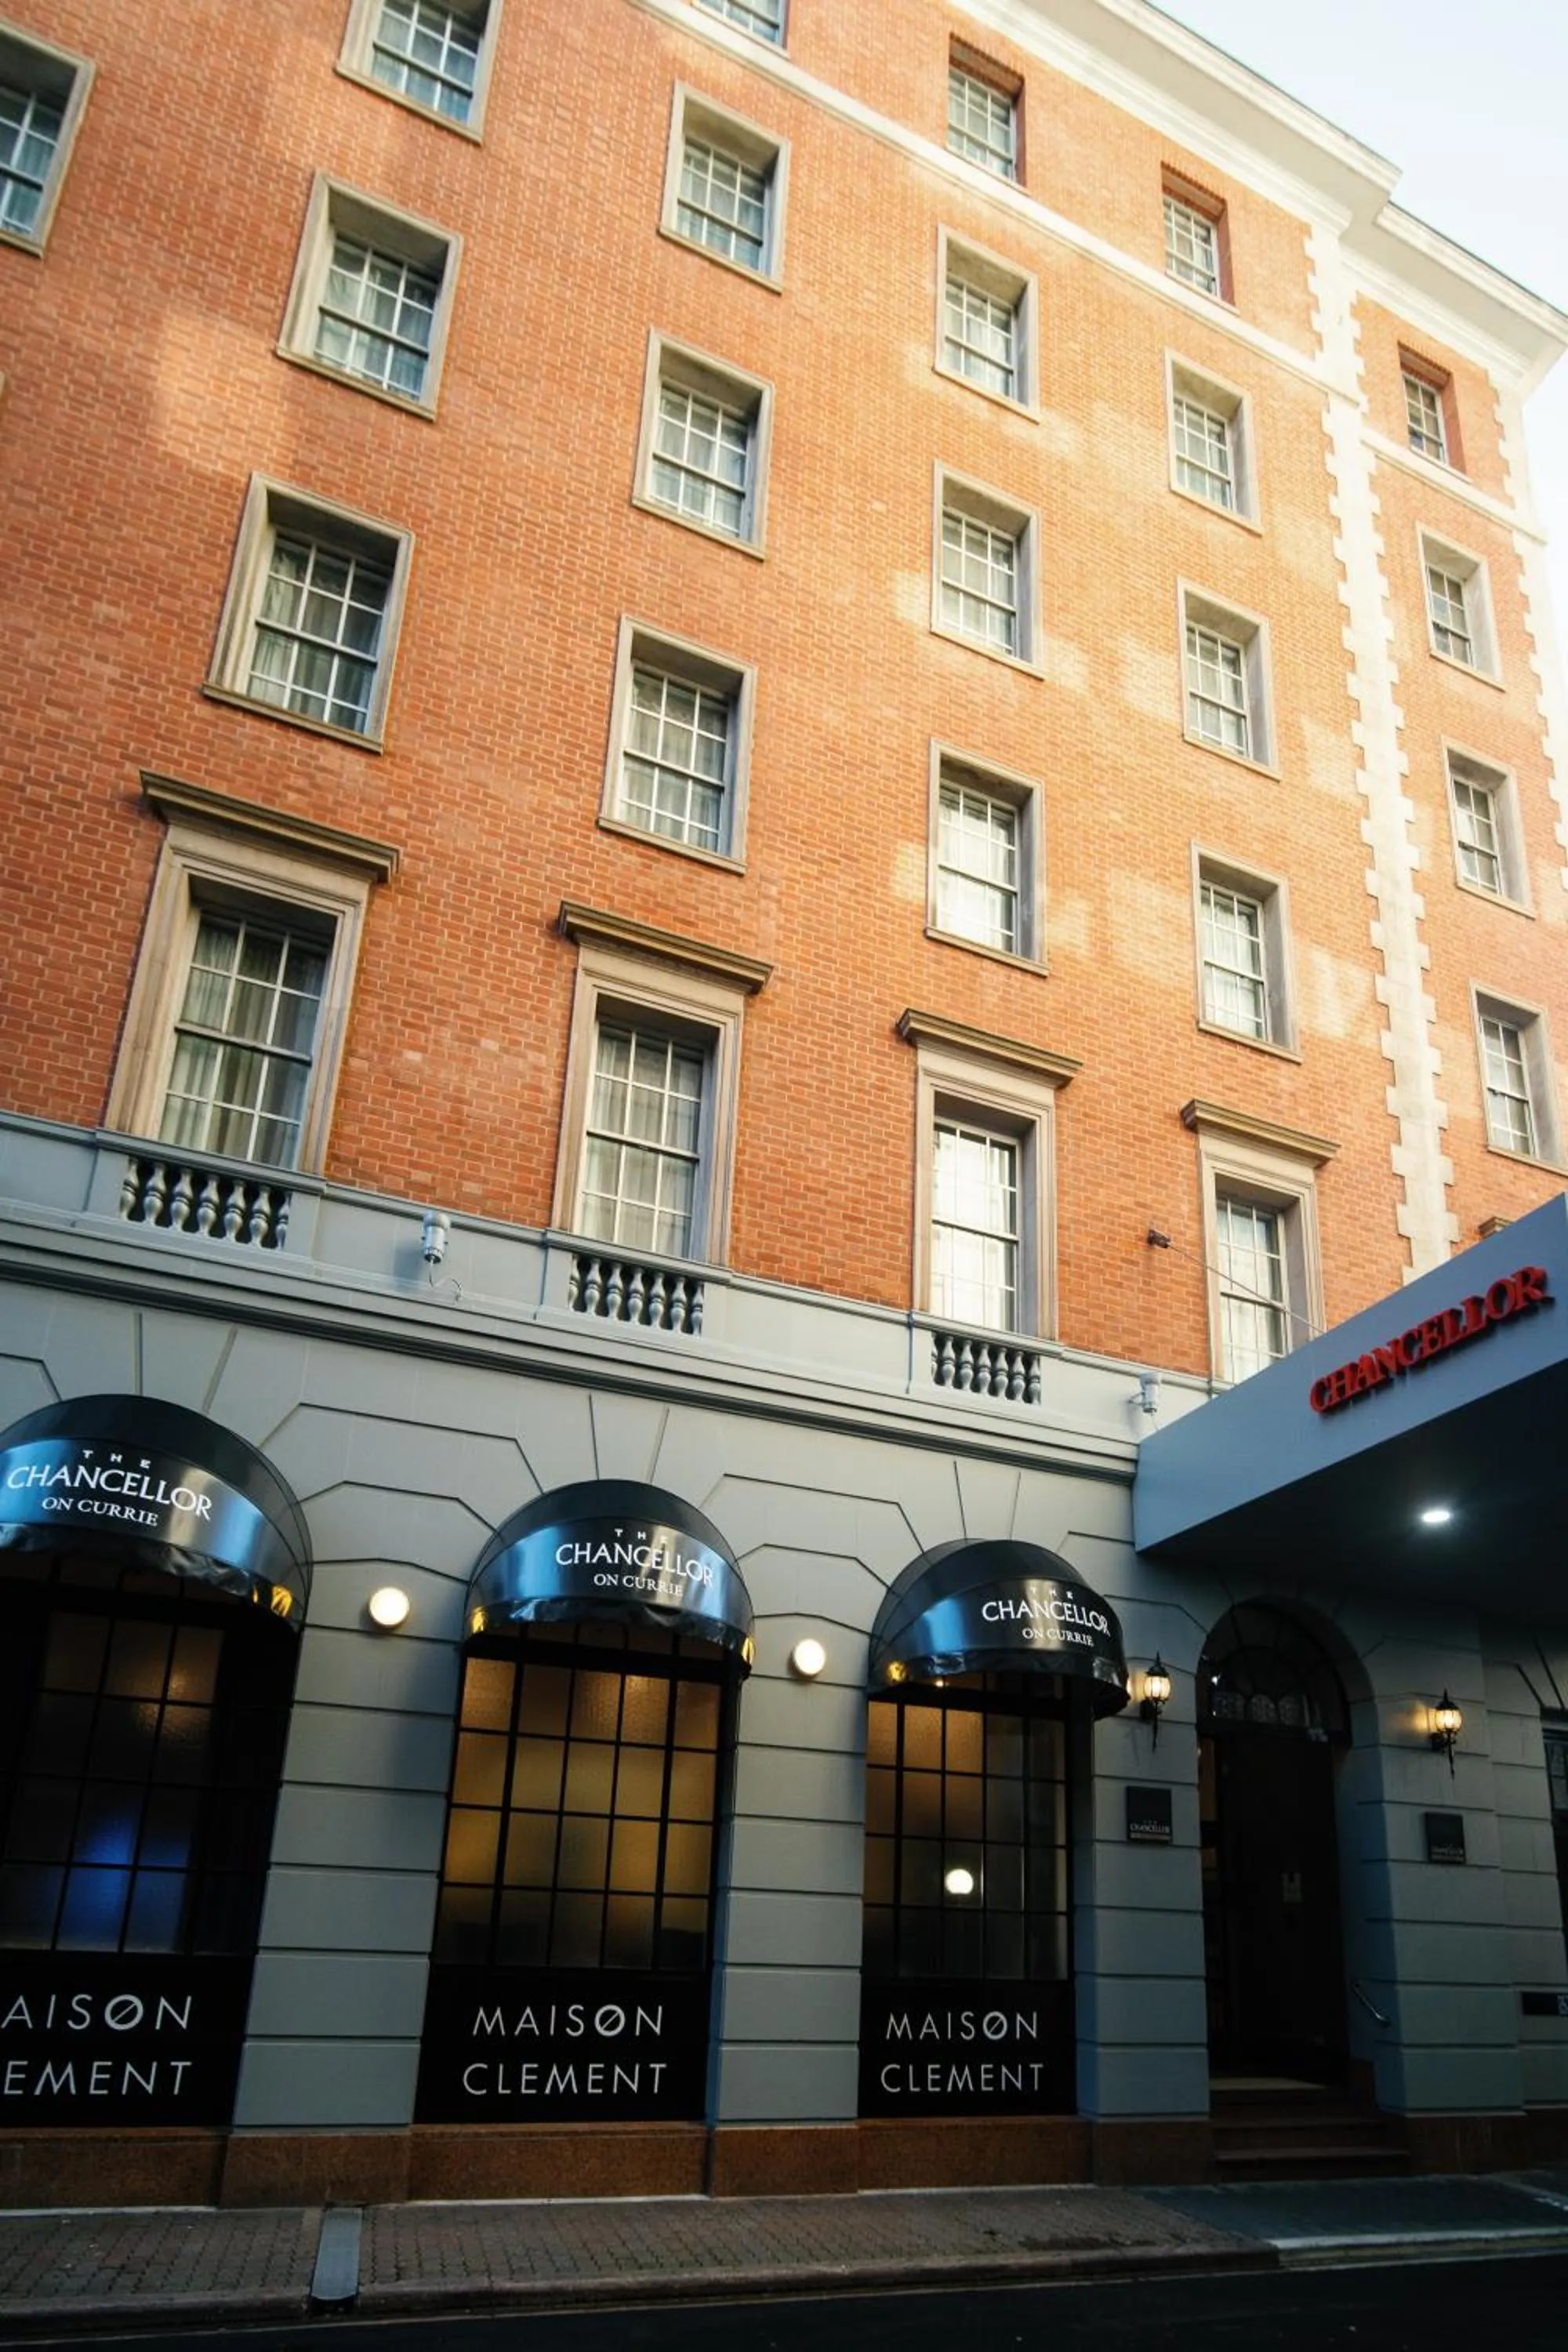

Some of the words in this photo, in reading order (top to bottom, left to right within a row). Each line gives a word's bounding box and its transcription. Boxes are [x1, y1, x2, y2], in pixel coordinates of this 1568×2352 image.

[1309, 1265, 1549, 1414] CHANCELLOR
[82, 1450, 151, 1469] THE
[7, 1465, 212, 1521] CHANCELLOR
[42, 1497, 74, 1511] ON
[78, 1499, 158, 1526] CURRIE
[614, 1528, 668, 1544] THE
[555, 1543, 714, 1588] CHANCELLOR
[593, 1573, 619, 1587] ON
[623, 1575, 683, 1596] CURRIE
[982, 1599, 1111, 1637] CHANCELLOR
[1022, 1627, 1044, 1639] ON
[1047, 1628, 1094, 1647] CURRIE
[3, 2060, 193, 2096] EMENT
[463, 2063, 667, 2096] CLEMENT
[880, 2063, 1044, 2092] CLEMENT
